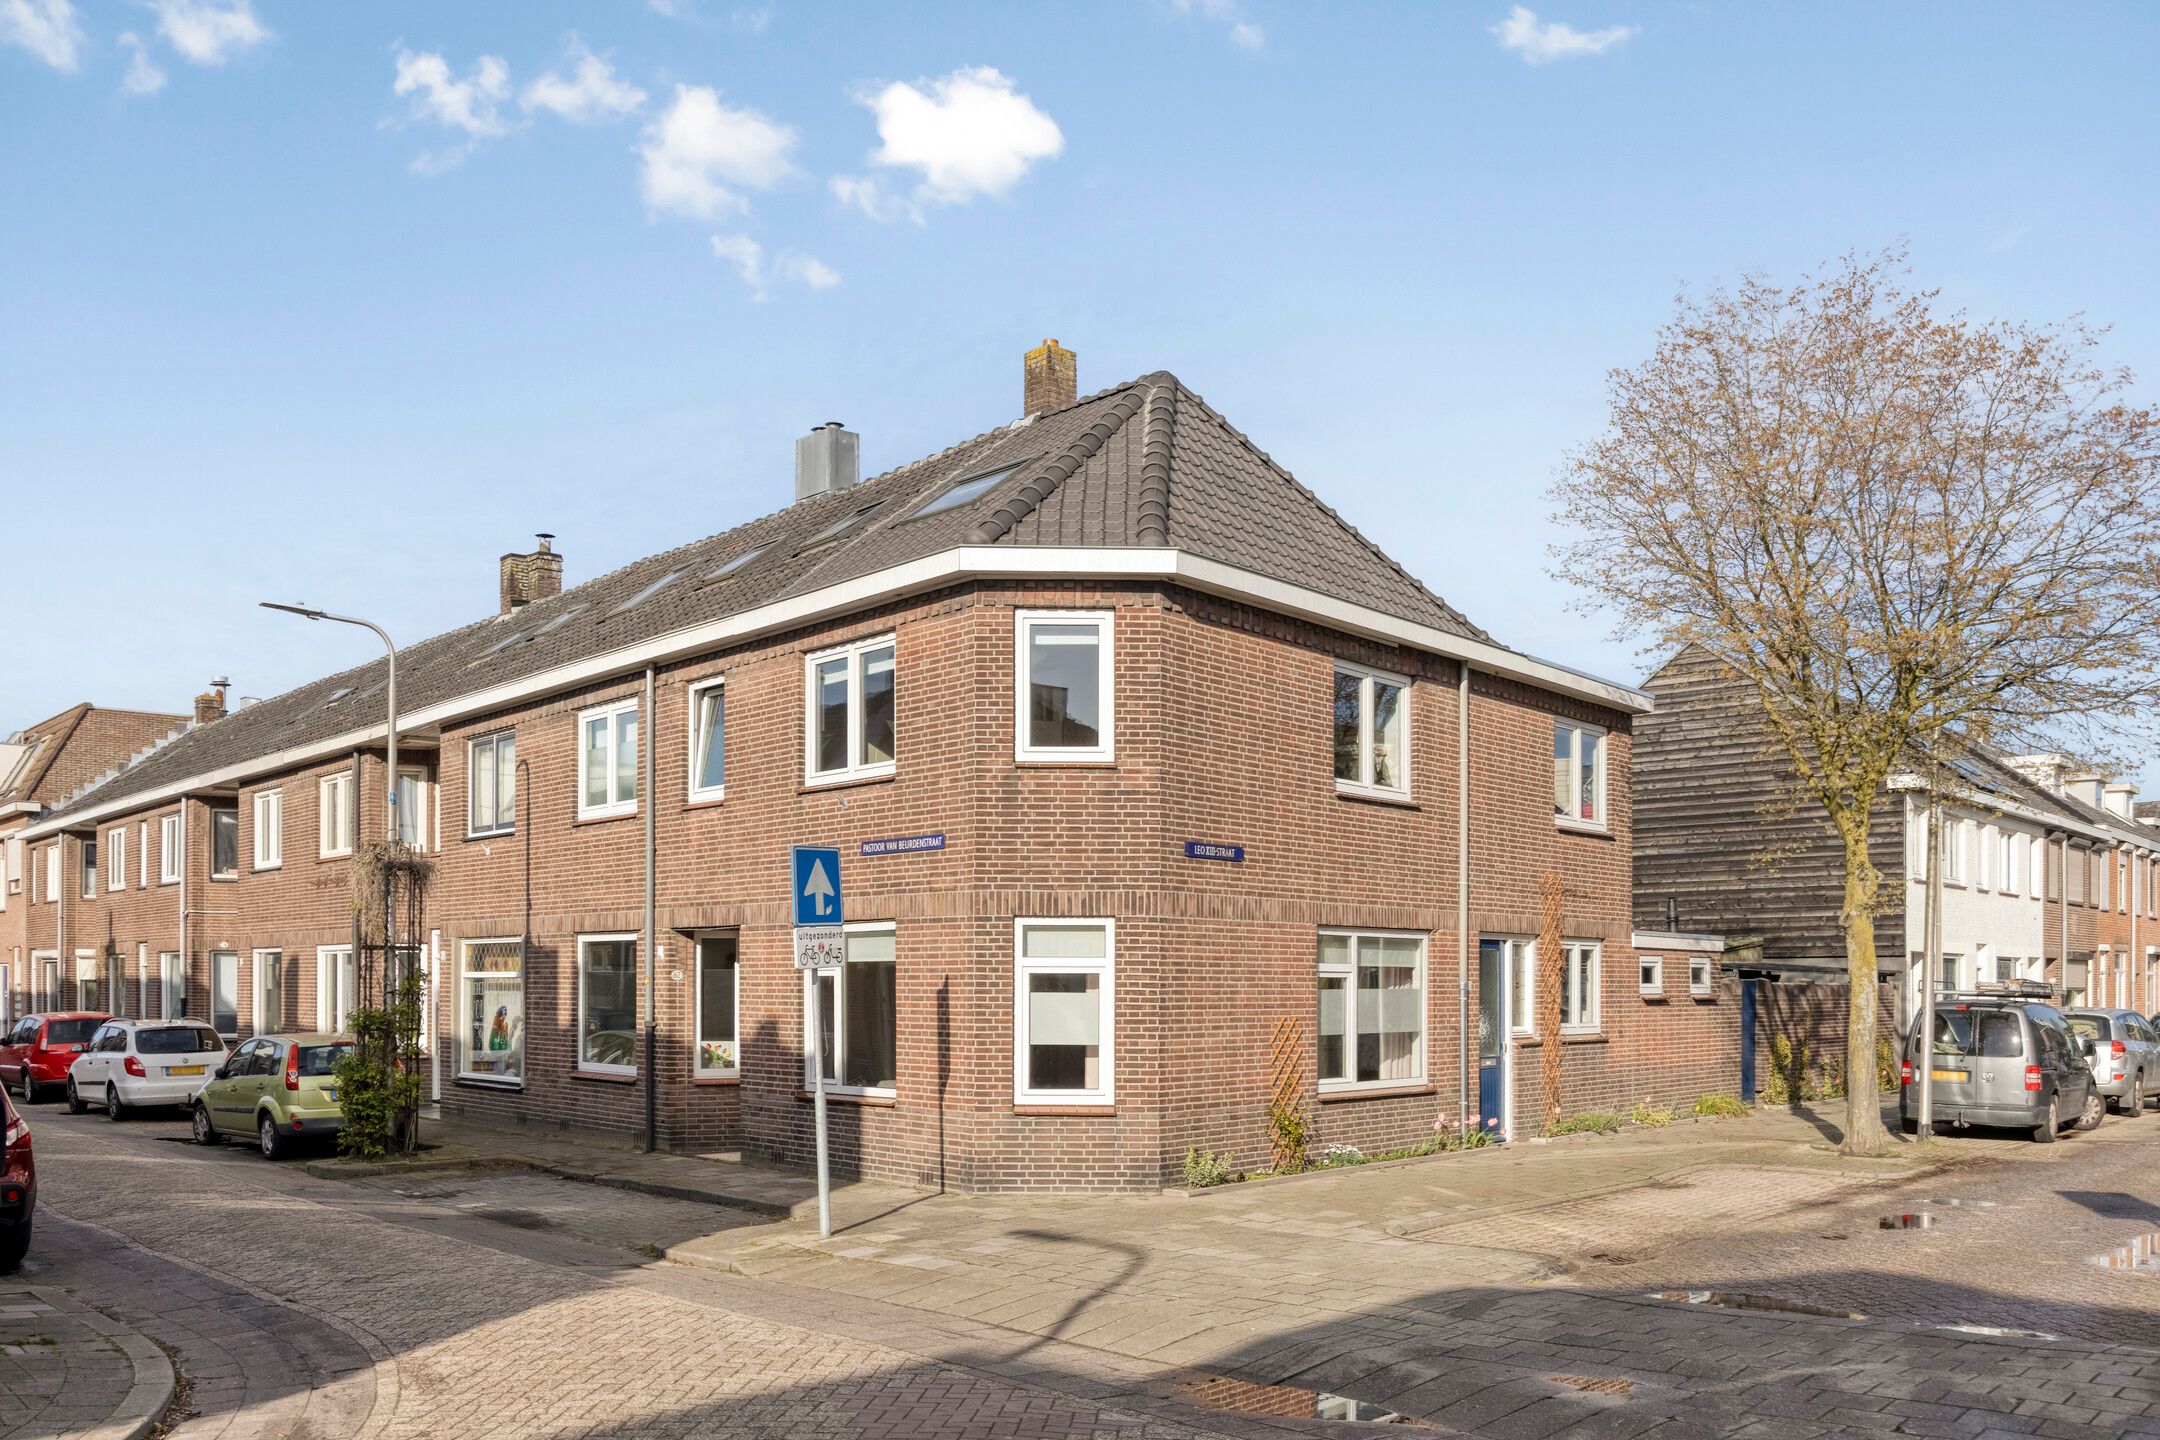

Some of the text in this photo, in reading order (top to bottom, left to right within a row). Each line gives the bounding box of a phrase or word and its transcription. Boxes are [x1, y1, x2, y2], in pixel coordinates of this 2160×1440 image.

[862, 837, 942, 853] PASTOOR VAN BEURDENSTRAAT
[1194, 845, 1205, 855] LEO
[798, 931, 842, 942] uitgezonderd
